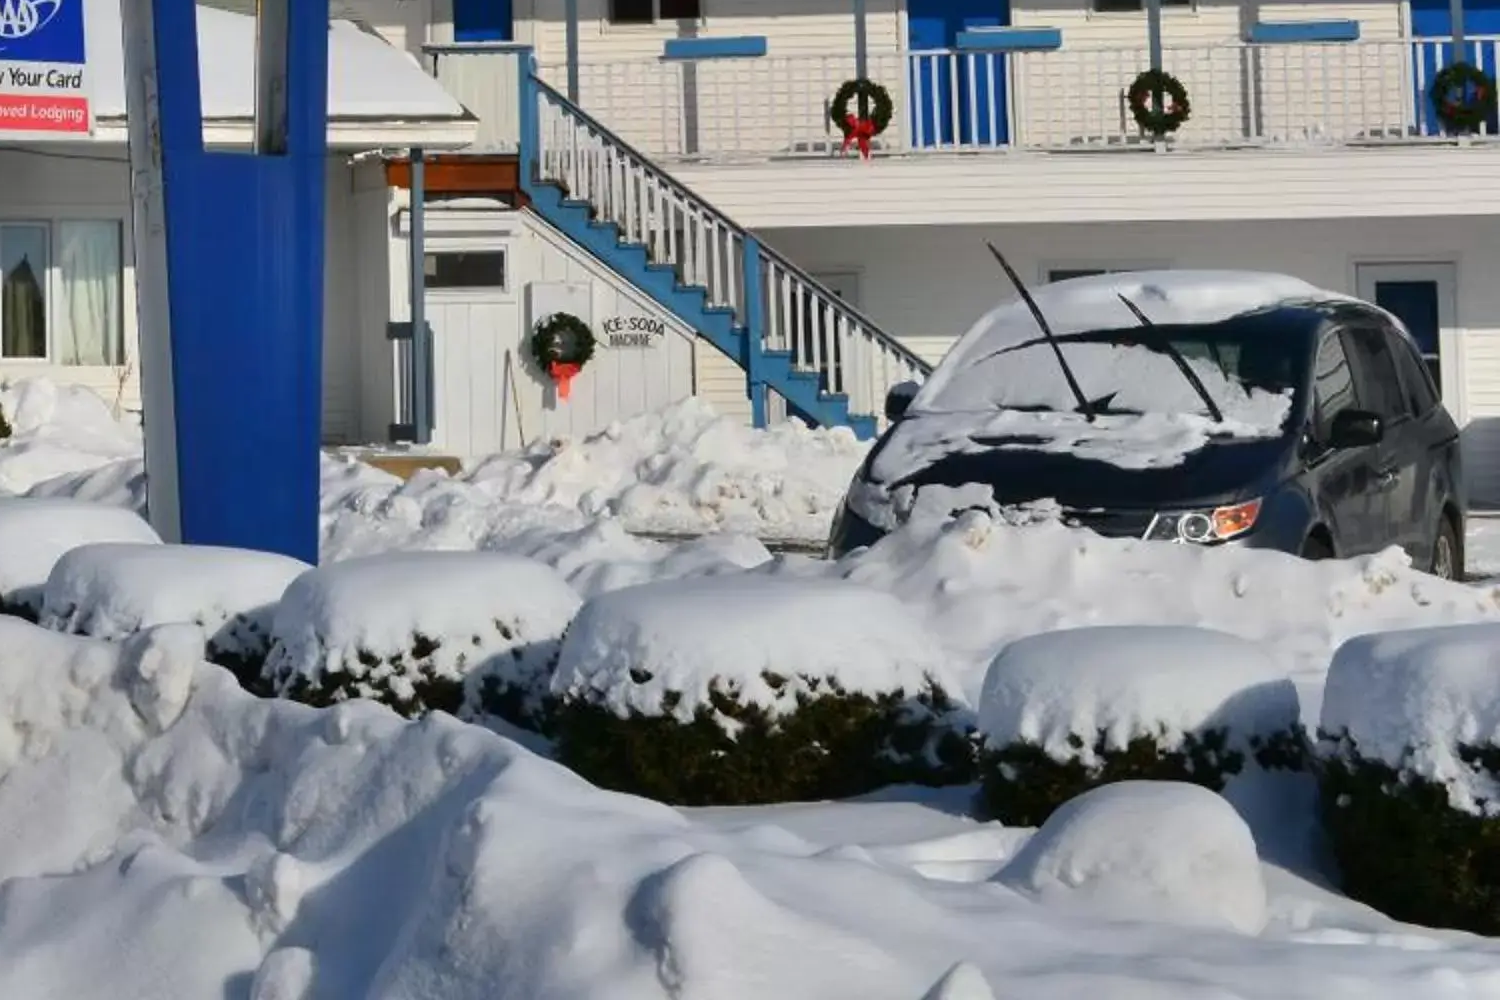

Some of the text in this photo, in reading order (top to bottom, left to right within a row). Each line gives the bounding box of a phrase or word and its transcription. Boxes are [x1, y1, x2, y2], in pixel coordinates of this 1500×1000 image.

[9, 67, 43, 87] Your
[46, 69, 83, 89] Card
[31, 104, 85, 123] Lodging
